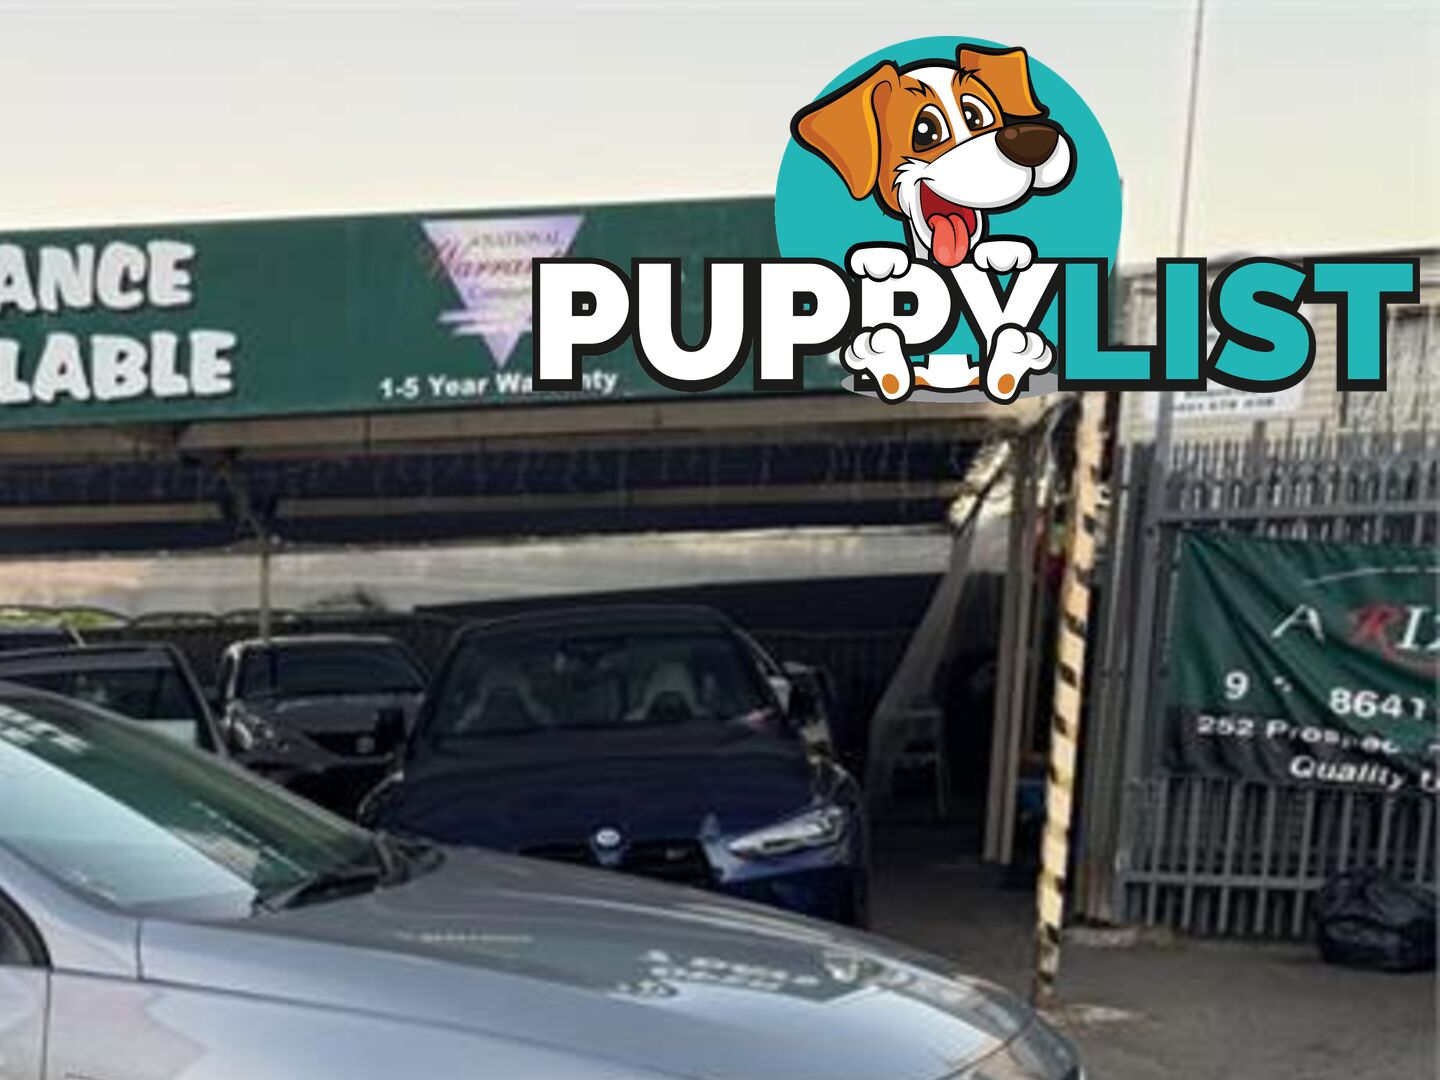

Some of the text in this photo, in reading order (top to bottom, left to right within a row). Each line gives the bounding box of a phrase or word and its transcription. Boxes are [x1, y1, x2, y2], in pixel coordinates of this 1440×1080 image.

[380, 370, 618, 398] 1-5 Year Wanty
[1197, 715, 1254, 737] 252
